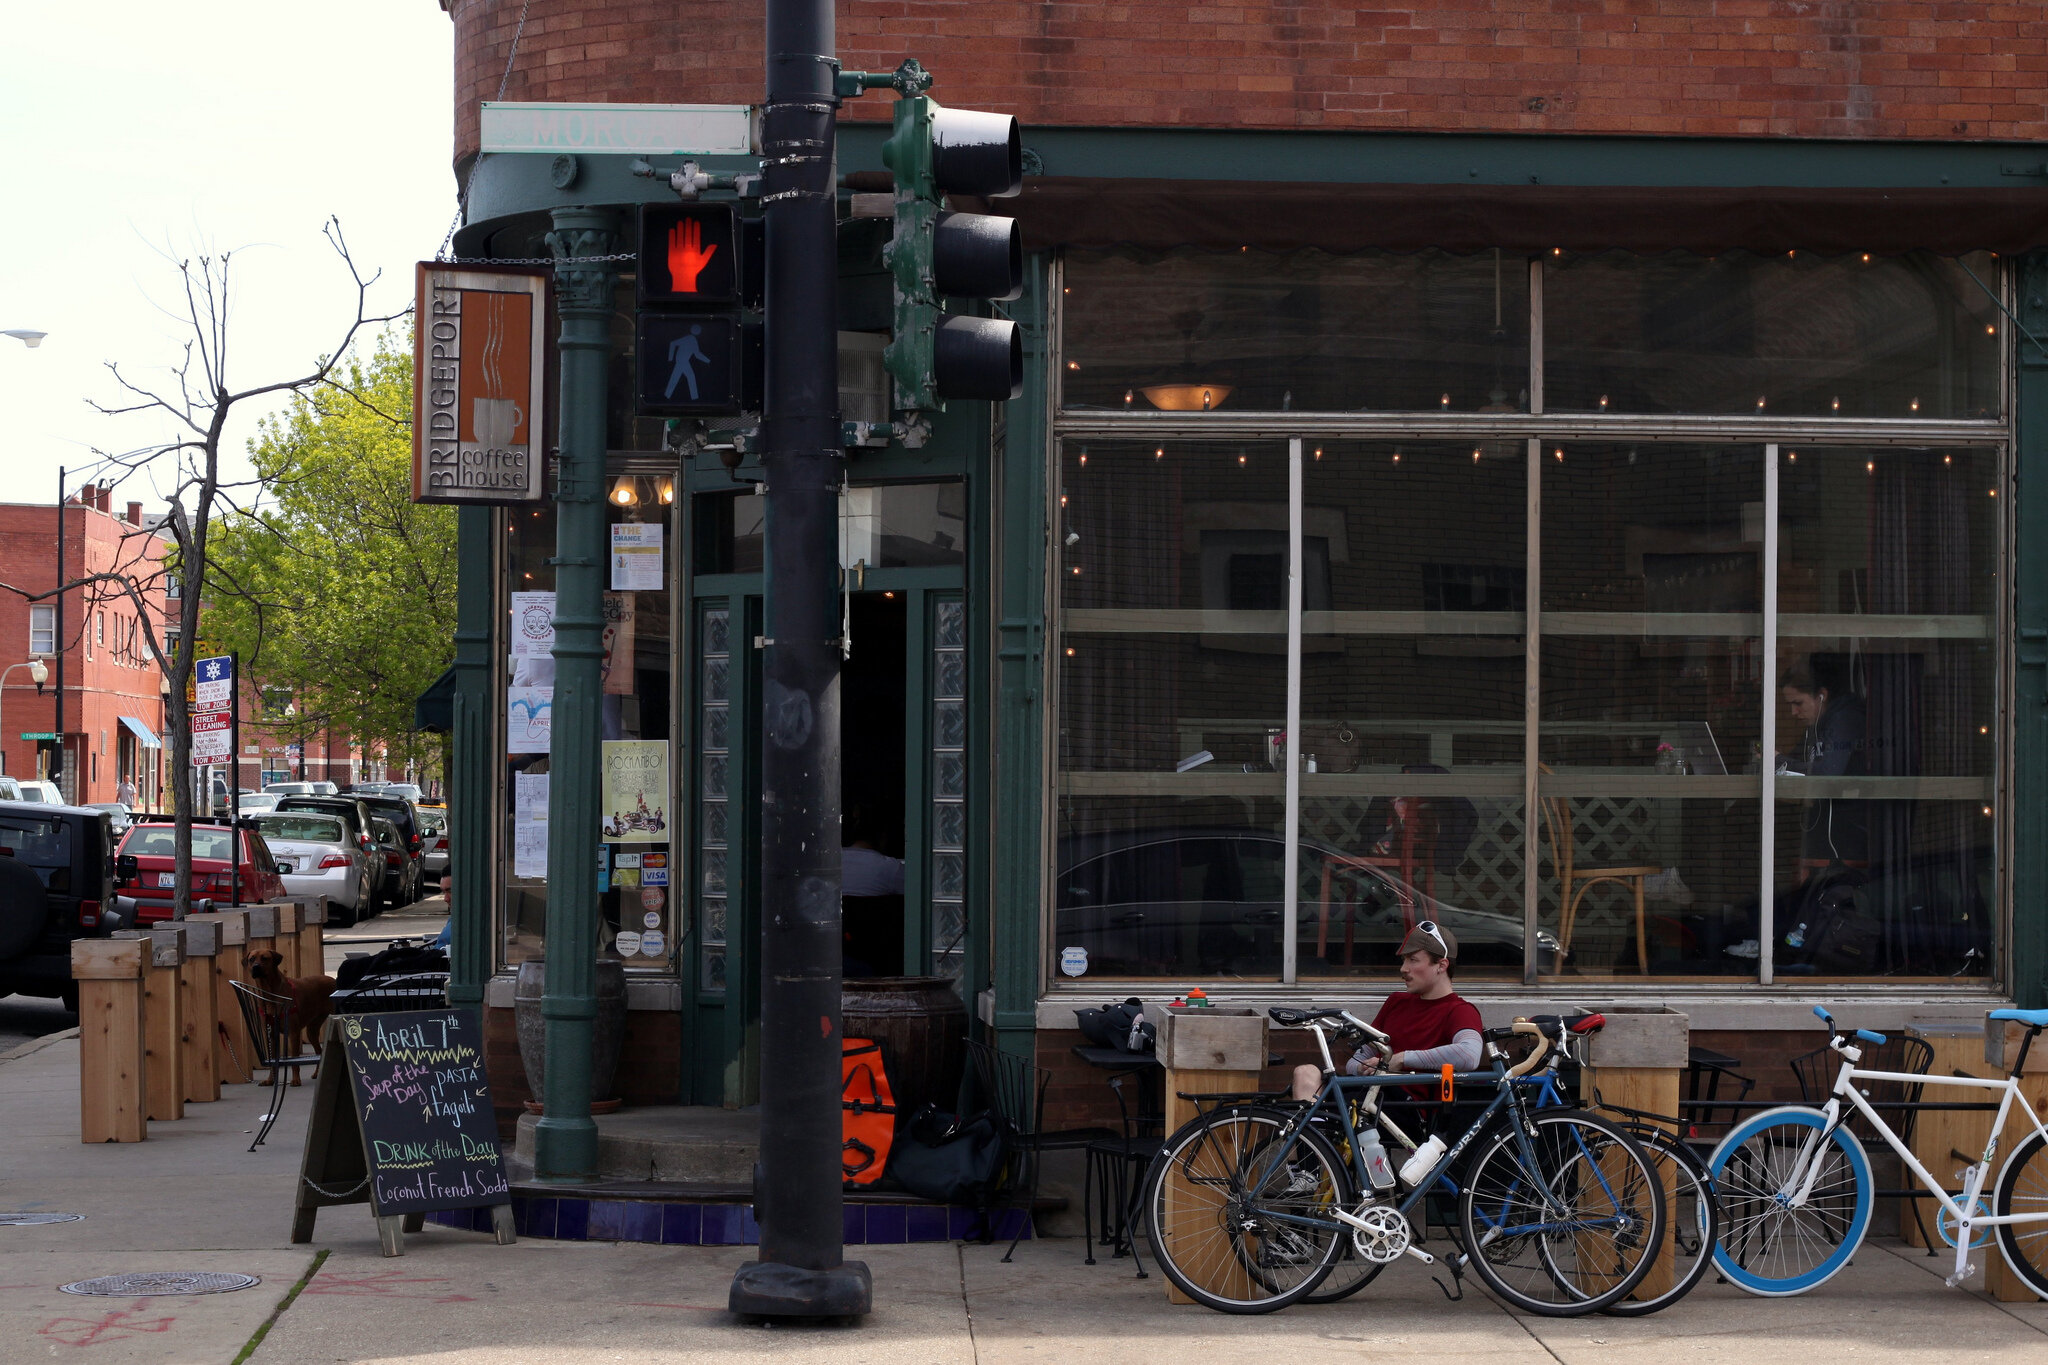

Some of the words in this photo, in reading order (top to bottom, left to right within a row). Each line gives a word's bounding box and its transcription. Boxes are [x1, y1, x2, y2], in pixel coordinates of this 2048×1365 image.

[533, 110, 698, 147] MORGAN
[430, 279, 461, 490] BRIDGEPORT
[462, 448, 524, 467] coffee
[462, 465, 524, 487] house
[621, 526, 642, 535] THE
[212, 700, 228, 708] ZONE
[195, 721, 227, 730] CLEANING
[196, 714, 218, 724] STREET
[646, 872, 666, 880] VISA
[428, 1015, 462, 1048] 7th
[362, 1074, 393, 1101] Soup
[392, 1064, 404, 1084] of
[404, 1064, 430, 1080] the
[393, 1082, 428, 1106] Day
[374, 1140, 432, 1163] DRINK
[460, 1132, 497, 1166] Day
[1450, 1120, 1482, 1160] SURLY
[376, 1172, 426, 1204] Coconut
[428, 1170, 474, 1198] French
[476, 1169, 508, 1196] Soda
